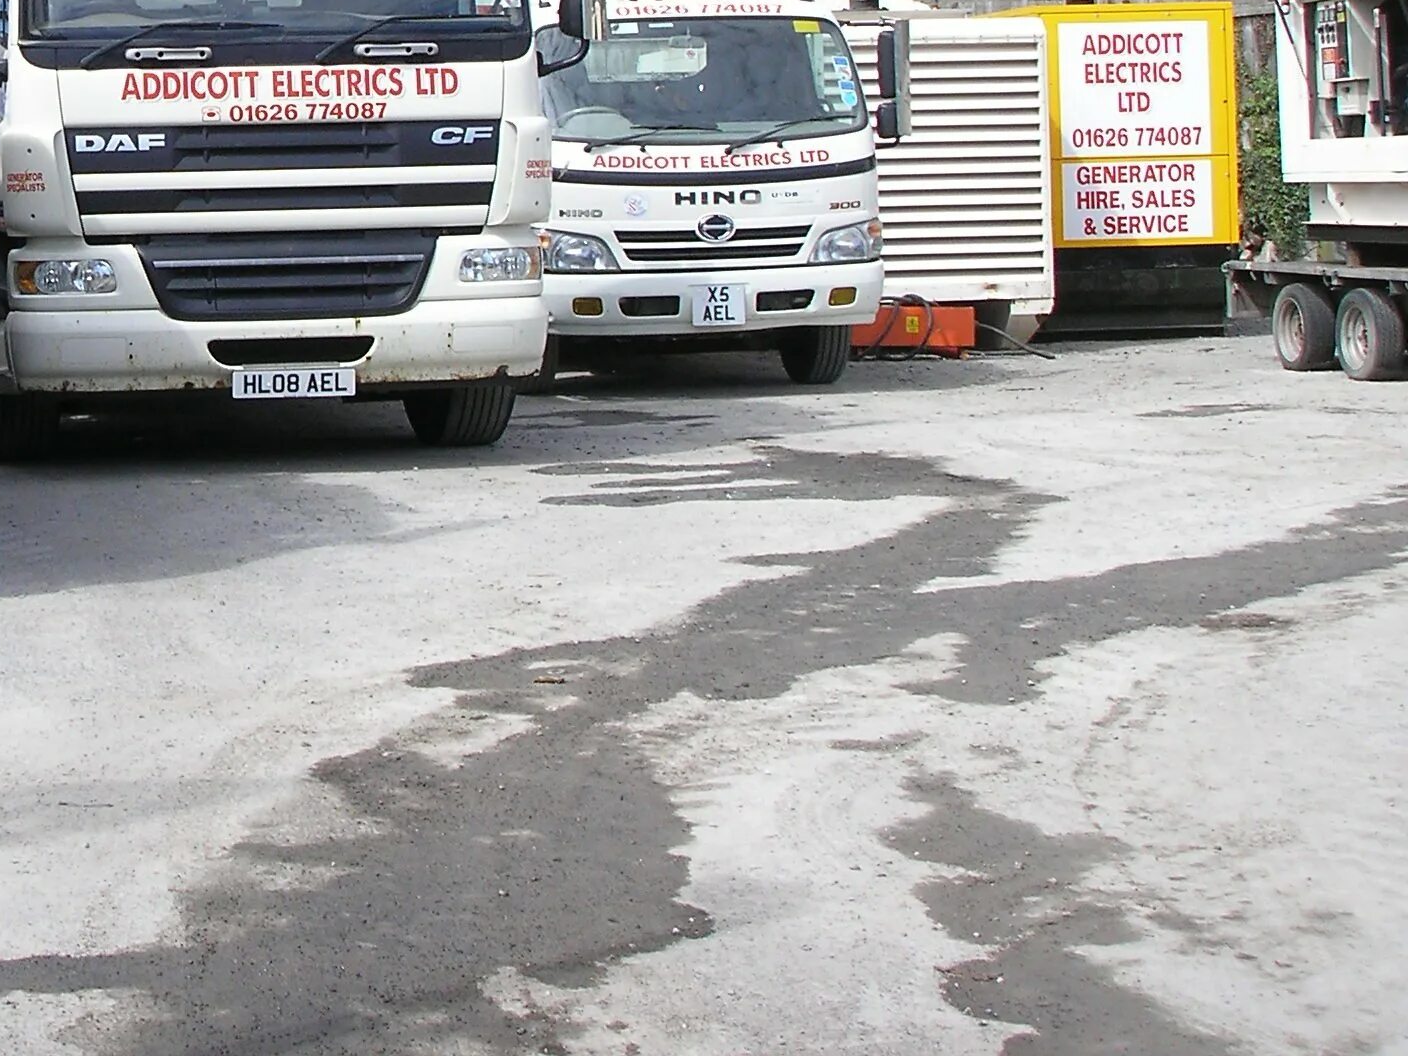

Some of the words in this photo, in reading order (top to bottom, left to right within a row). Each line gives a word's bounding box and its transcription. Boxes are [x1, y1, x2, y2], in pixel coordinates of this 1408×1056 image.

[615, 5, 689, 16] 01626
[700, 4, 783, 15] 774087
[1082, 33, 1183, 55] ADDICOTT
[1084, 62, 1182, 84] ELECTRICS
[121, 71, 259, 101] ADDICOTT
[272, 67, 403, 98] ELECTRICS
[415, 68, 458, 95] LTD
[229, 104, 298, 122] 01626
[306, 102, 387, 120] 774087
[1118, 92, 1151, 113] LTD
[75, 133, 166, 152] DAF
[430, 126, 494, 145] CF
[1072, 128, 1129, 148] 01626
[1135, 127, 1202, 146] 774087
[593, 154, 690, 169] ADDICOTT
[700, 152, 791, 168] ELECTRICS
[800, 150, 830, 163] LTD
[1076, 164, 1195, 185] GENERATOR
[675, 189, 762, 205] HINO
[829, 200, 861, 210] 300
[1076, 191, 1125, 211] HIRE,
[1132, 189, 1196, 209] SALES
[1084, 218, 1097, 235] &
[1103, 215, 1188, 234] SERVICE
[708, 286, 729, 302] X5
[703, 305, 735, 321] AEL
[244, 374, 300, 394] HL08
[306, 372, 347, 392] AEL
